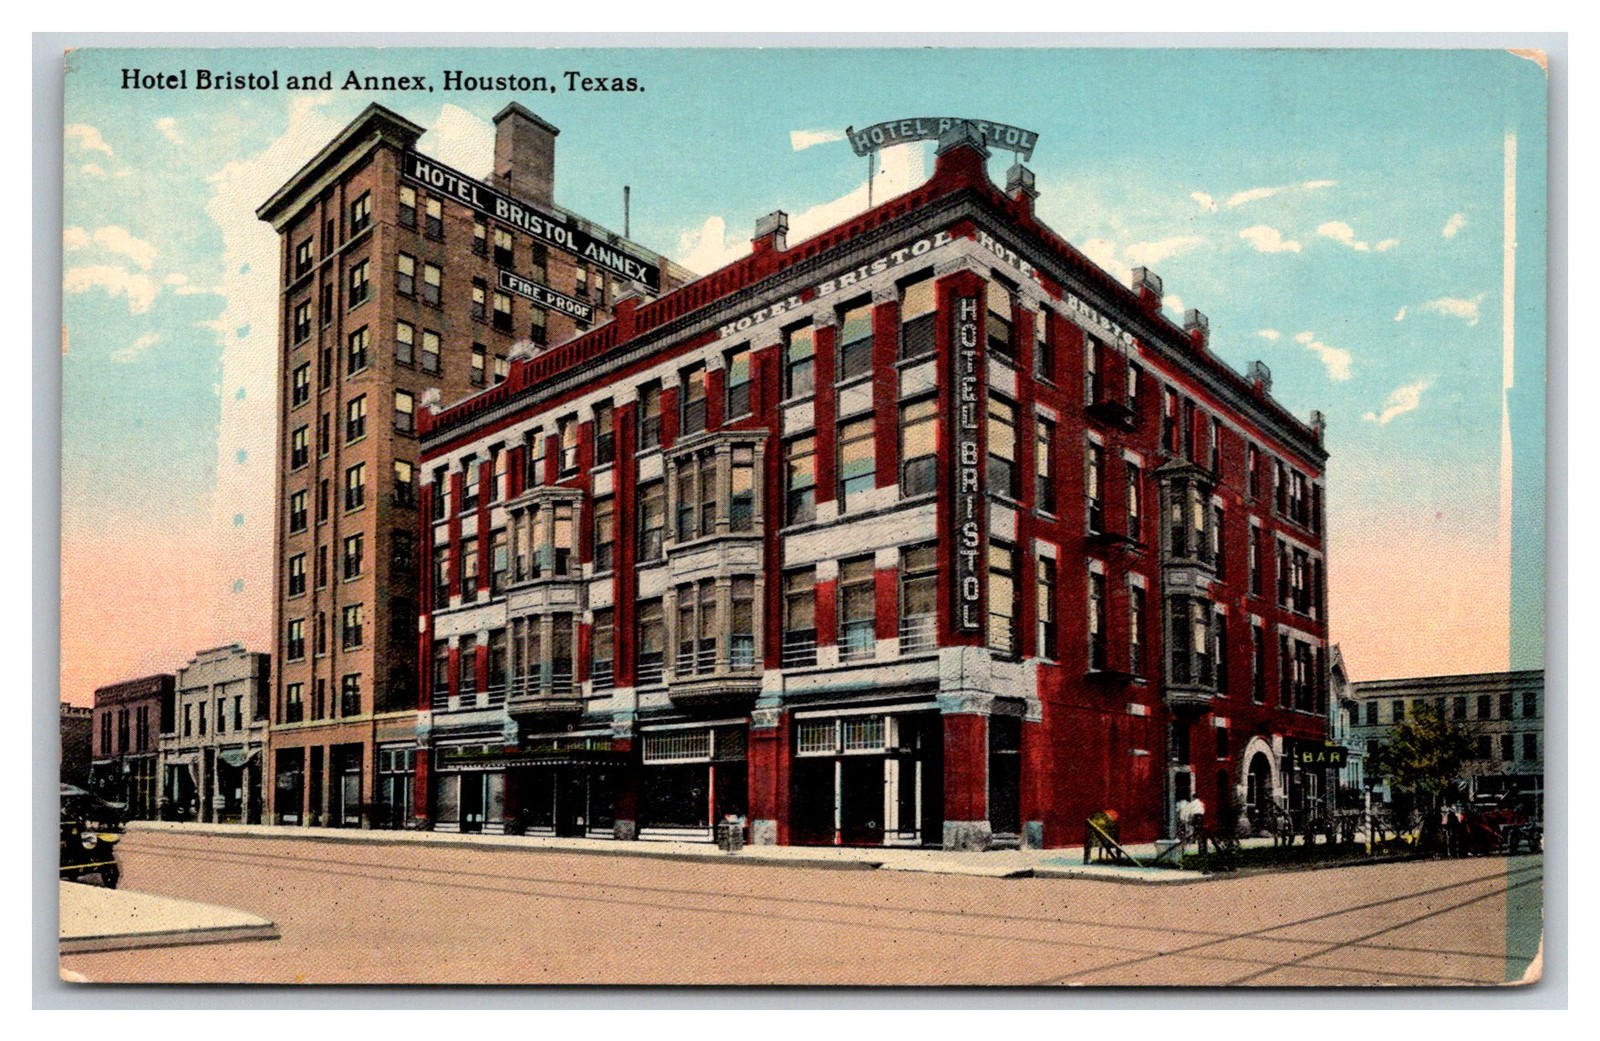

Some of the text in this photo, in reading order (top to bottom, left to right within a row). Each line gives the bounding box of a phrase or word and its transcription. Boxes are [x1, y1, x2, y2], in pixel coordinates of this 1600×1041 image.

[855, 120, 928, 150] HOTEL
[415, 161, 648, 284] HOTEL BRISTOL ANNEX
[509, 277, 590, 318] FIRE PROOF
[719, 231, 952, 339] HOTEL BRISTOL
[960, 297, 980, 629] HOTEL BRISTOL
[1302, 751, 1341, 764] BAR
